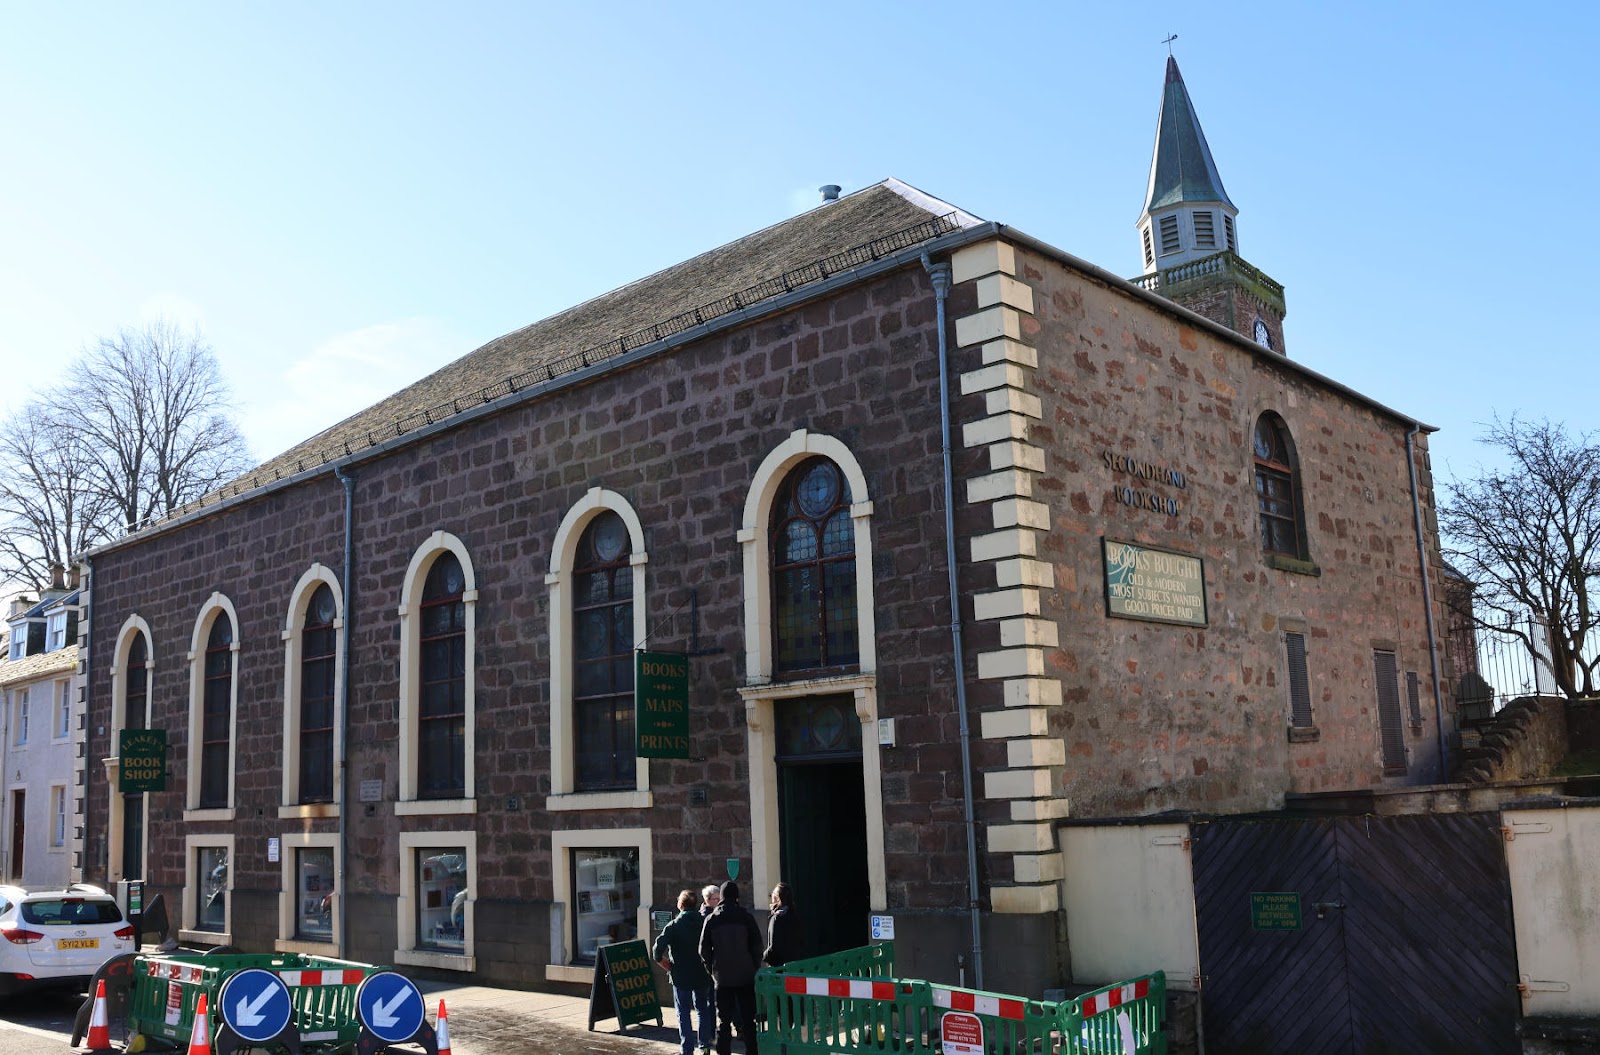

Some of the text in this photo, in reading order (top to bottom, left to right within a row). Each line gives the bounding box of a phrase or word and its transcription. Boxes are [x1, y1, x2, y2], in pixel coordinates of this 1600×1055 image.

[1103, 451, 1186, 489] SECONDHAND
[1114, 485, 1182, 517] BOOKSHOP
[1109, 547, 1199, 579] BOOKS BOUGHT
[1128, 573, 1187, 592] OLD & MODERN
[1113, 585, 1201, 607] MOST SUBJECTS WANTED
[1124, 600, 1193, 619] GOOD PRICES PAID
[642, 662, 686, 677] BOOKS
[646, 698, 683, 712] MAPS
[640, 735, 688, 749] PRINTS
[124, 757, 161, 767] BOOK
[124, 769, 160, 780] SHOP
[611, 957, 649, 975] BOOK
[616, 973, 651, 992] SHOP
[620, 991, 656, 1009] OPEN
